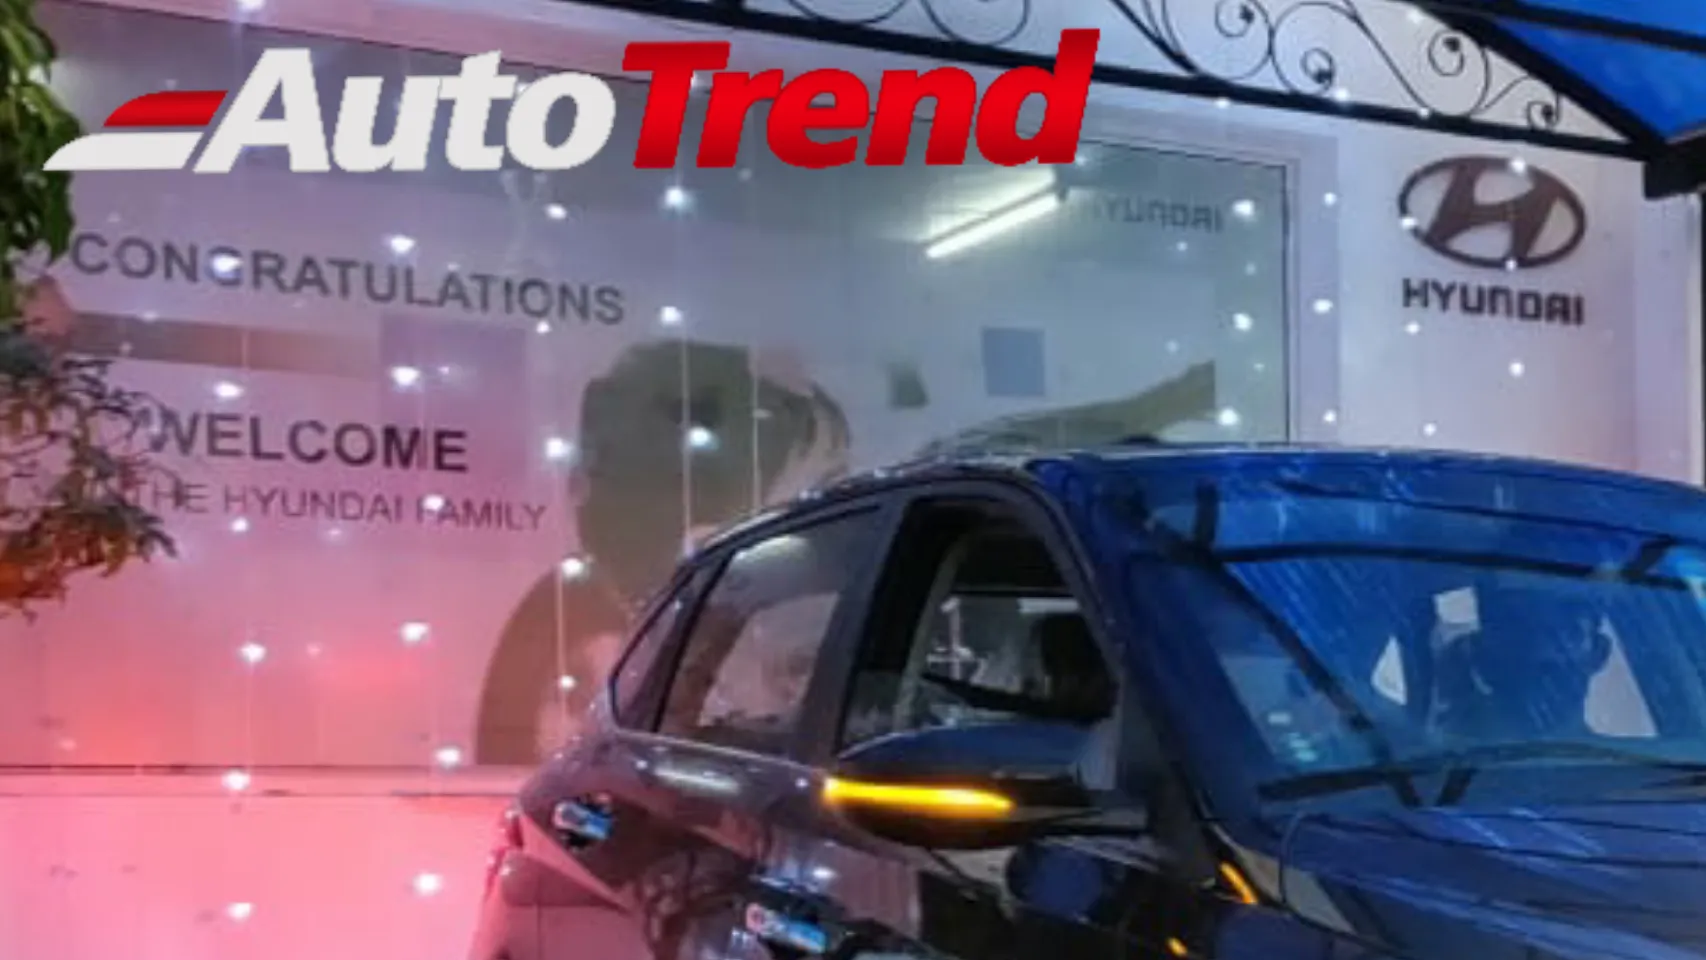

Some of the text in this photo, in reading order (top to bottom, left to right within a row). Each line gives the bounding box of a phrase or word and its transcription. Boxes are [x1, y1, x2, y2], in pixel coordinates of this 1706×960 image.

[1082, 194, 1225, 236] YUNDAI
[71, 233, 624, 325] CONGRATULATIONS
[1402, 277, 1585, 327] HYUNDAI
[142, 408, 469, 474] WELCOME
[223, 483, 403, 524] HYUNDAI
